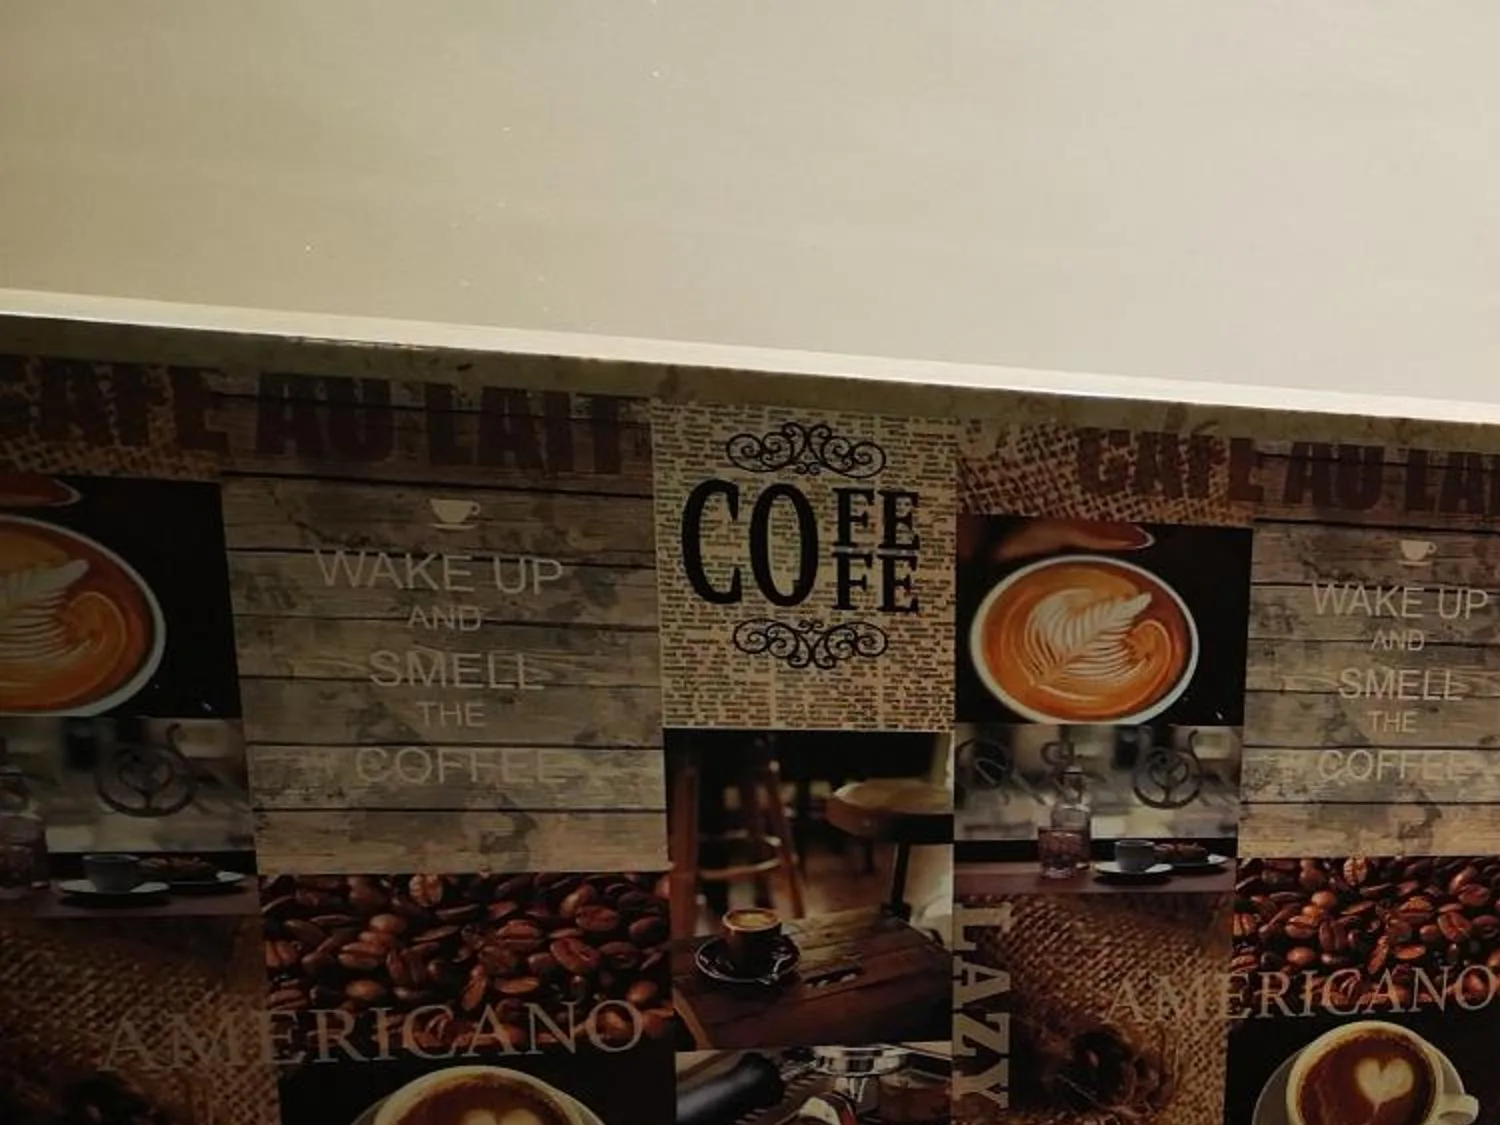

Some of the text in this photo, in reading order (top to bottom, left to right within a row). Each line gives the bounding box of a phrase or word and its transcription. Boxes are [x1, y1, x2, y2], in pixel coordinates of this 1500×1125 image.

[314, 549, 563, 596] WAKE UP
[408, 604, 485, 632] AND
[1312, 583, 1489, 621] WAKE UP
[1370, 629, 1425, 652] AND
[369, 649, 544, 691] SMELL
[1338, 667, 1463, 701] SMELL
[416, 701, 488, 727] THE
[1366, 710, 1418, 733] THE
[355, 748, 568, 785] COFFEE
[1317, 749, 1470, 782] COFFEE
[951, 899, 1013, 1110] LAZY
[1098, 962, 1498, 1021] AMERICANO
[98, 998, 642, 1073] AMERICANO
